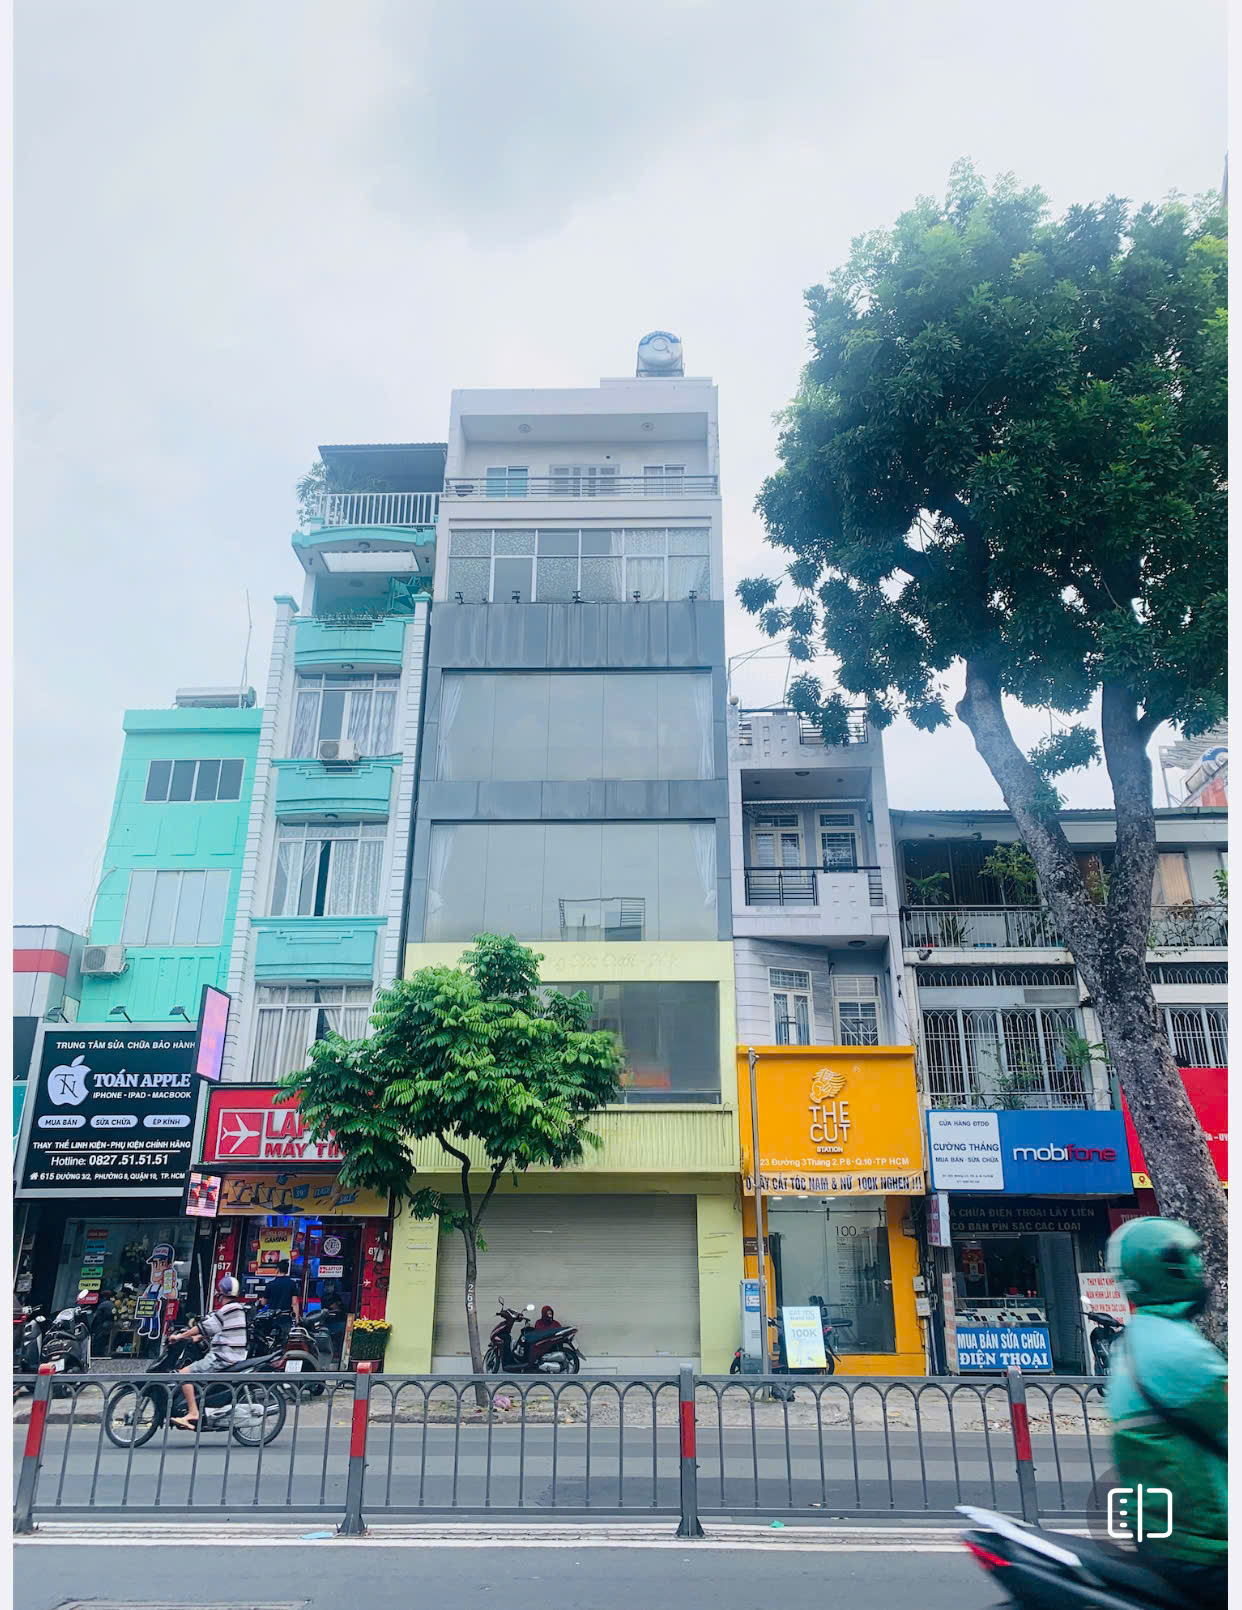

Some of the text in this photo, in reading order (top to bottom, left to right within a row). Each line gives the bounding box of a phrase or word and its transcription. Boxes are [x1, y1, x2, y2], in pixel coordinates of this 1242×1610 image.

[56, 1039, 196, 1049] TRUNG TÂM SỬA CHỮA BẢO HÀNH
[93, 1068, 191, 1087] TOÁN APPLE
[808, 1101, 850, 1123] THE
[810, 1124, 851, 1142] CUT
[55, 1139, 69, 1149] THẾ
[127, 1141, 144, 1150] KIỆN
[145, 1139, 168, 1148] CHÍNH
[170, 1140, 191, 1148] HÃNG
[265, 1138, 308, 1157] MÁY
[933, 1142, 966, 1151] CƯỜNG
[1012, 1142, 1116, 1161] mobifone
[51, 1156, 86, 1166] Hotline:
[772, 1158, 800, 1167] Đường
[130, 1173, 148, 1181] QUẬN
[790, 1174, 806, 1190] TÓC
[809, 1177, 829, 1190] NAM
[831, 1177, 837, 1190] &
[840, 1175, 852, 1190] NỮ
[857, 1176, 878, 1190] 100K
[880, 1177, 910, 1190] NGHEN
[912, 1176, 922, 1190] !!!
[834, 1225, 856, 1237] 100
[218, 1262, 231, 1270] 617
[791, 1329, 817, 1337] 100K
[957, 1328, 1046, 1349] MUA BÁN SỬA CHỮA
[960, 1349, 1048, 1368] ĐIỆN THOẠI
